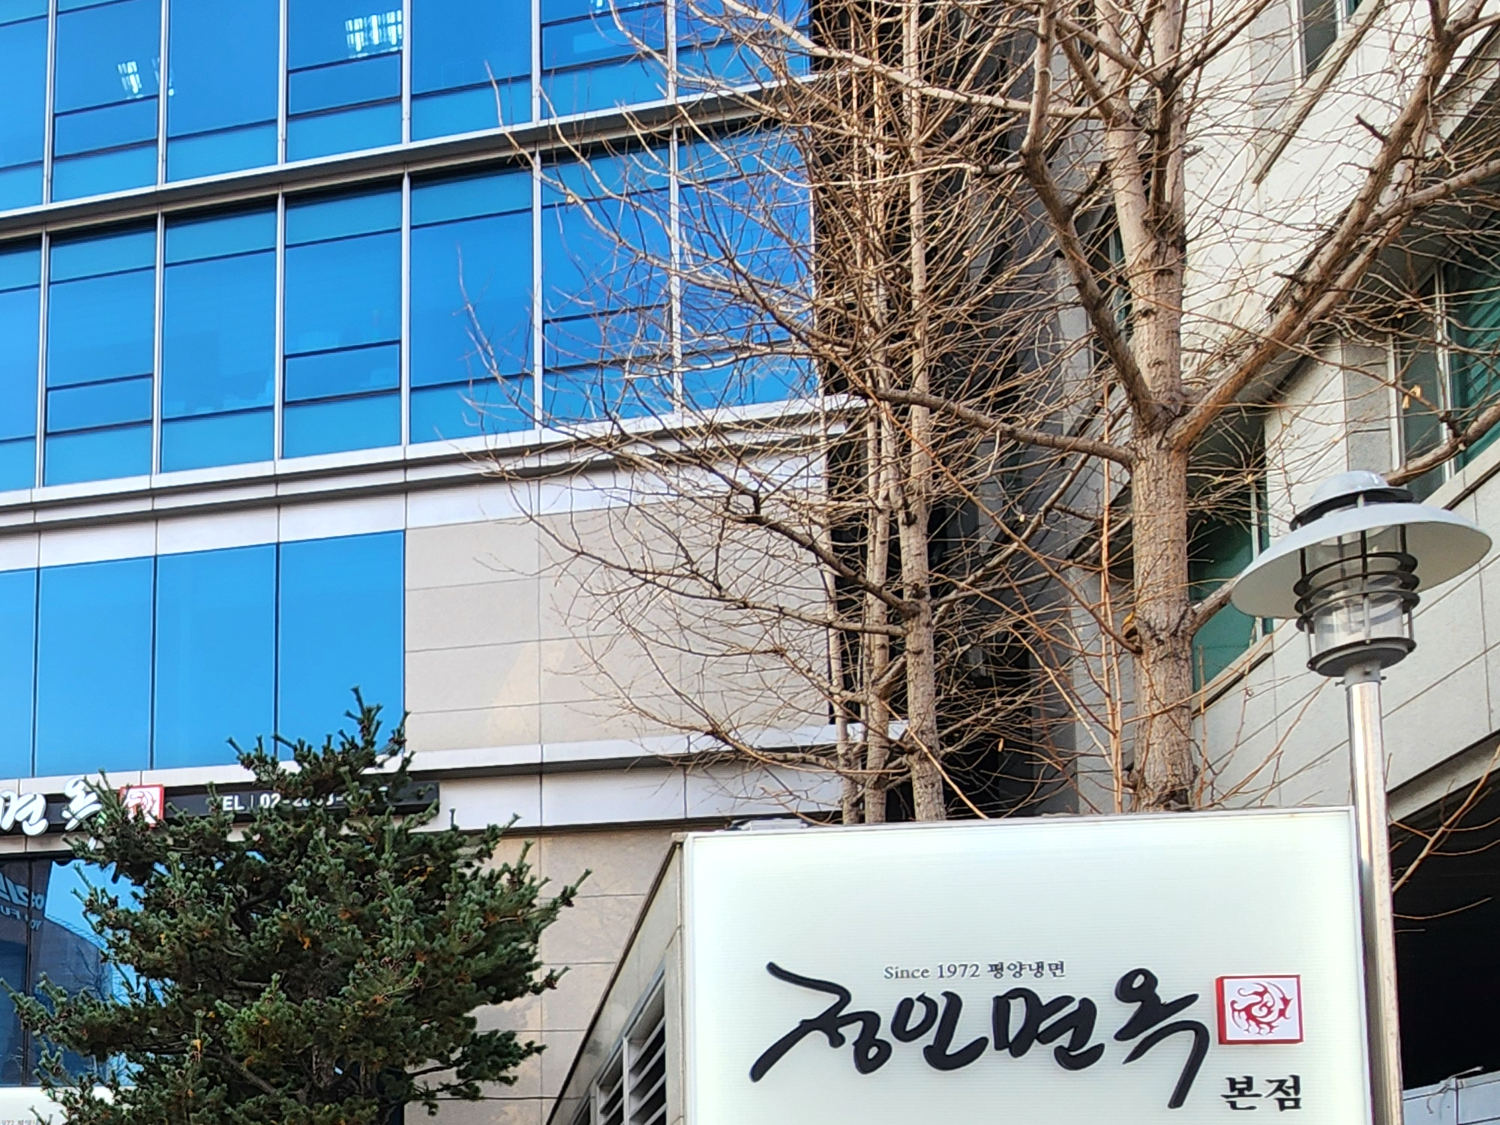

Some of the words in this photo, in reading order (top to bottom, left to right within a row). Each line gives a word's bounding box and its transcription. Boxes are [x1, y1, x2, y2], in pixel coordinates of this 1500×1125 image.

[222, 796, 245, 811] EL
[884, 964, 929, 980] Since
[937, 963, 980, 979] 1972
[987, 960, 1066, 979] 평양냉면
[749, 961, 1210, 1109] 정인면옥
[1221, 1074, 1302, 1111] 본점
